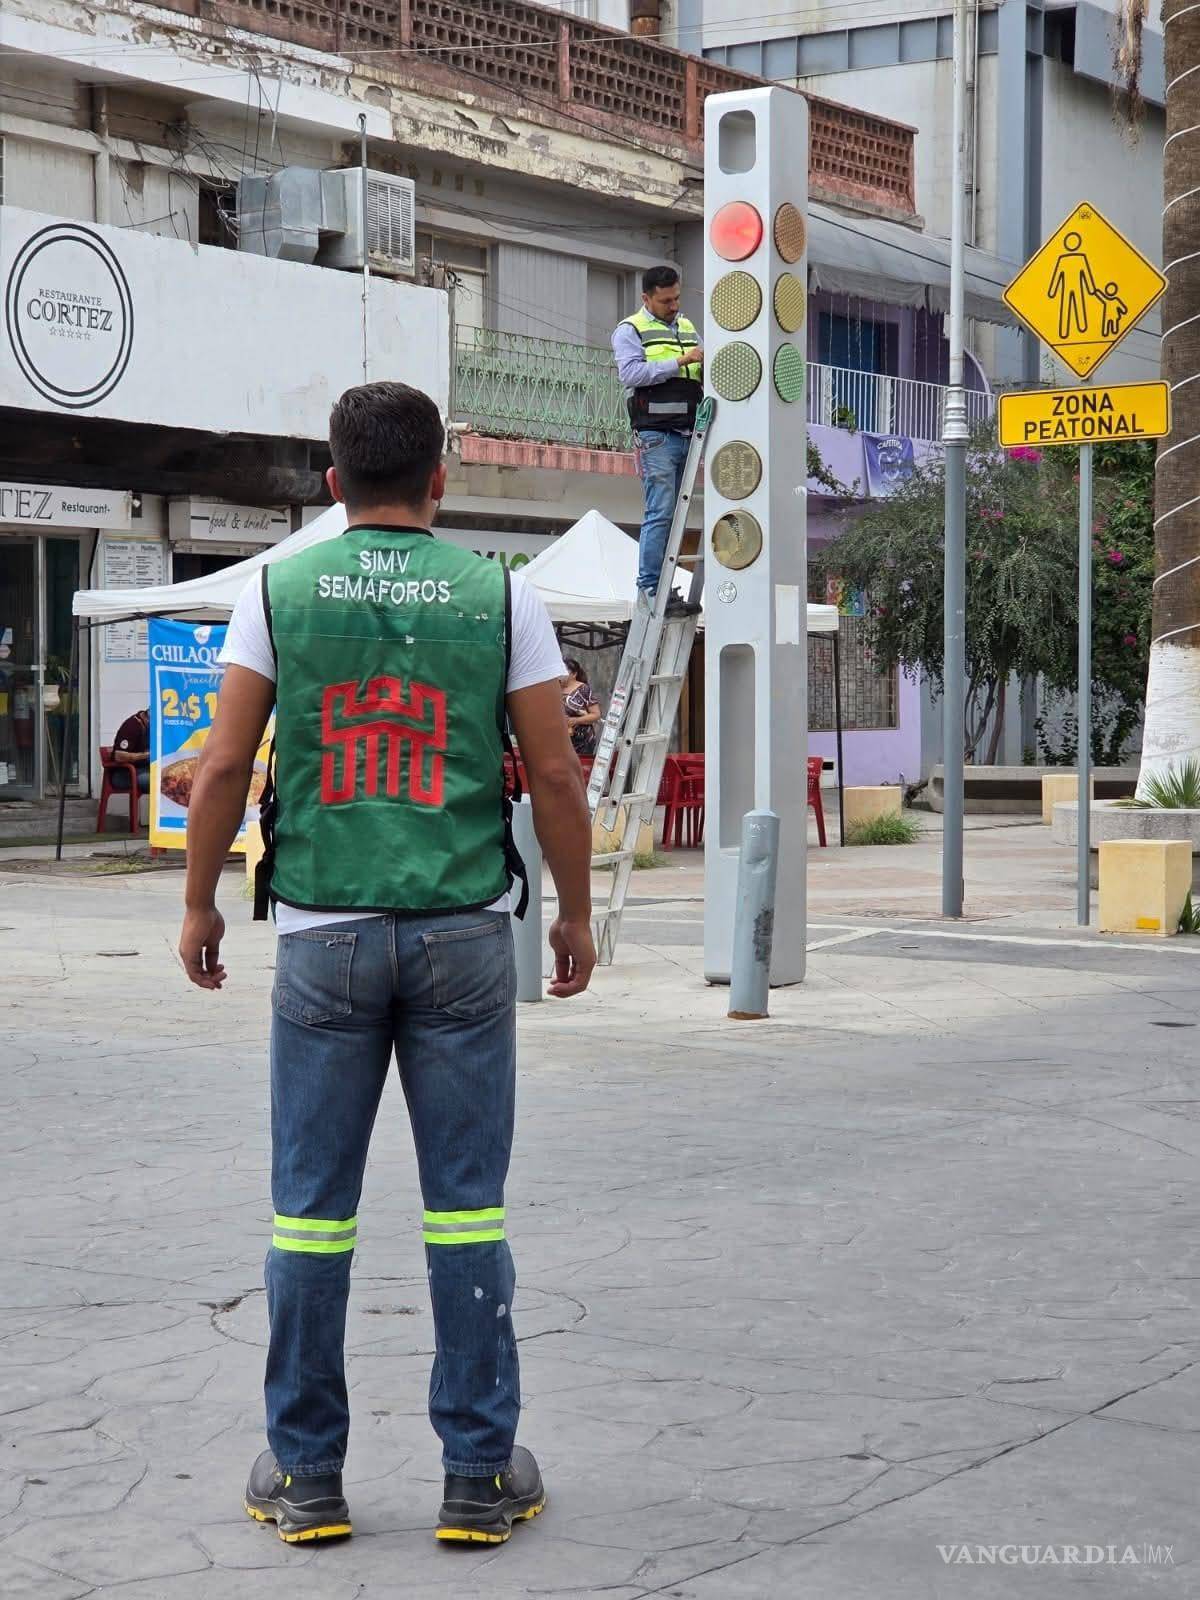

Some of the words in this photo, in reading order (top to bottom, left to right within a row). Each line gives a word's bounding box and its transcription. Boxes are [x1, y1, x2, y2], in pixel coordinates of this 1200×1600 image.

[39, 288, 102, 306] RESTAURANTE
[27, 298, 113, 332] CORTEZ
[1052, 393, 1114, 416] ZONA
[1024, 413, 1145, 441] PEATONAL
[208, 511, 229, 533] food
[231, 512, 241, 530] &
[243, 511, 271, 530] drinks
[359, 550, 411, 574] SIMV
[318, 569, 451, 605] SEMÁFOROS
